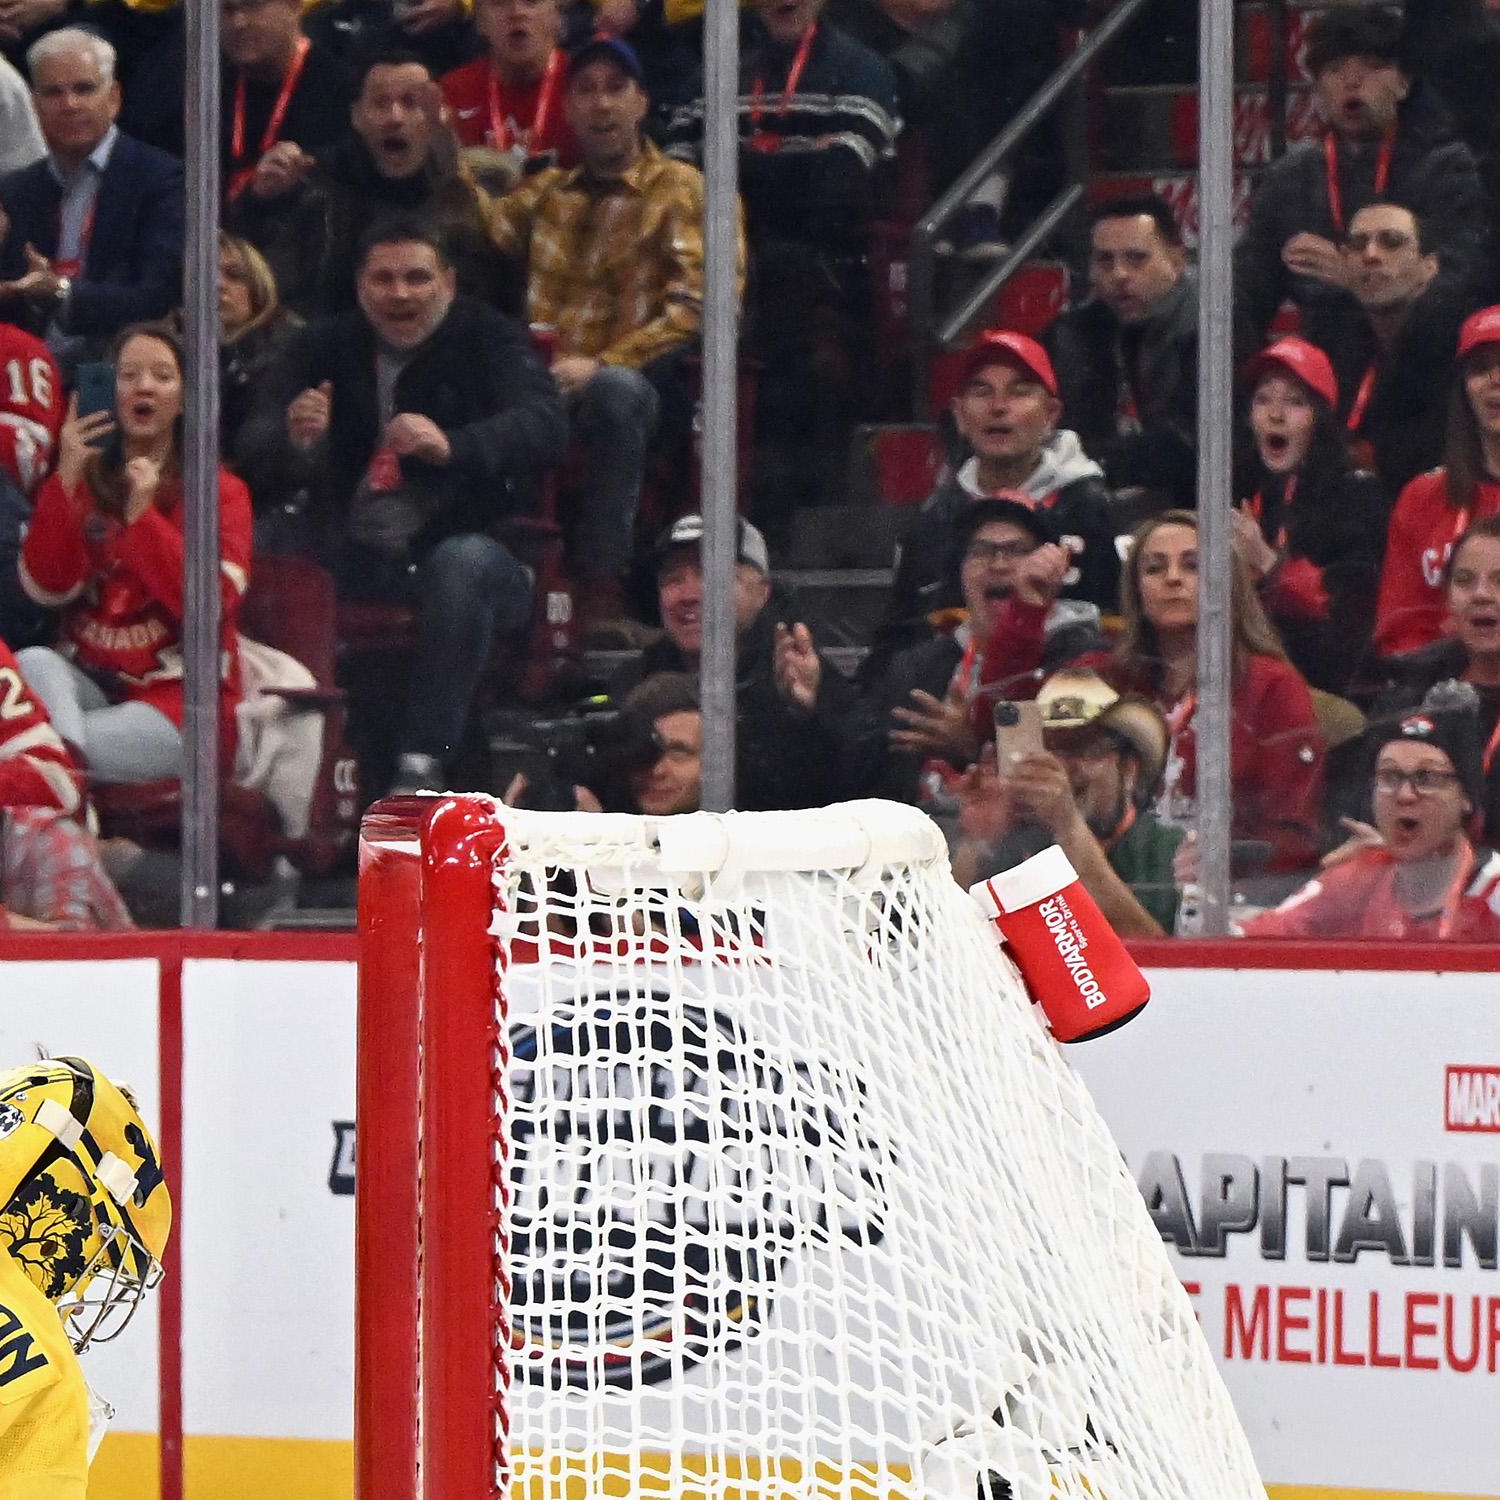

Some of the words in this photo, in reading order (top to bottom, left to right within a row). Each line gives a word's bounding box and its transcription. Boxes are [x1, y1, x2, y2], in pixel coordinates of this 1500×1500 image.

[1055, 893, 1075, 921] Drink
[1067, 920, 1089, 950] Sports
[1038, 897, 1107, 1010] BODYARMOR
[1136, 1149, 1499, 1271] APITAIN
